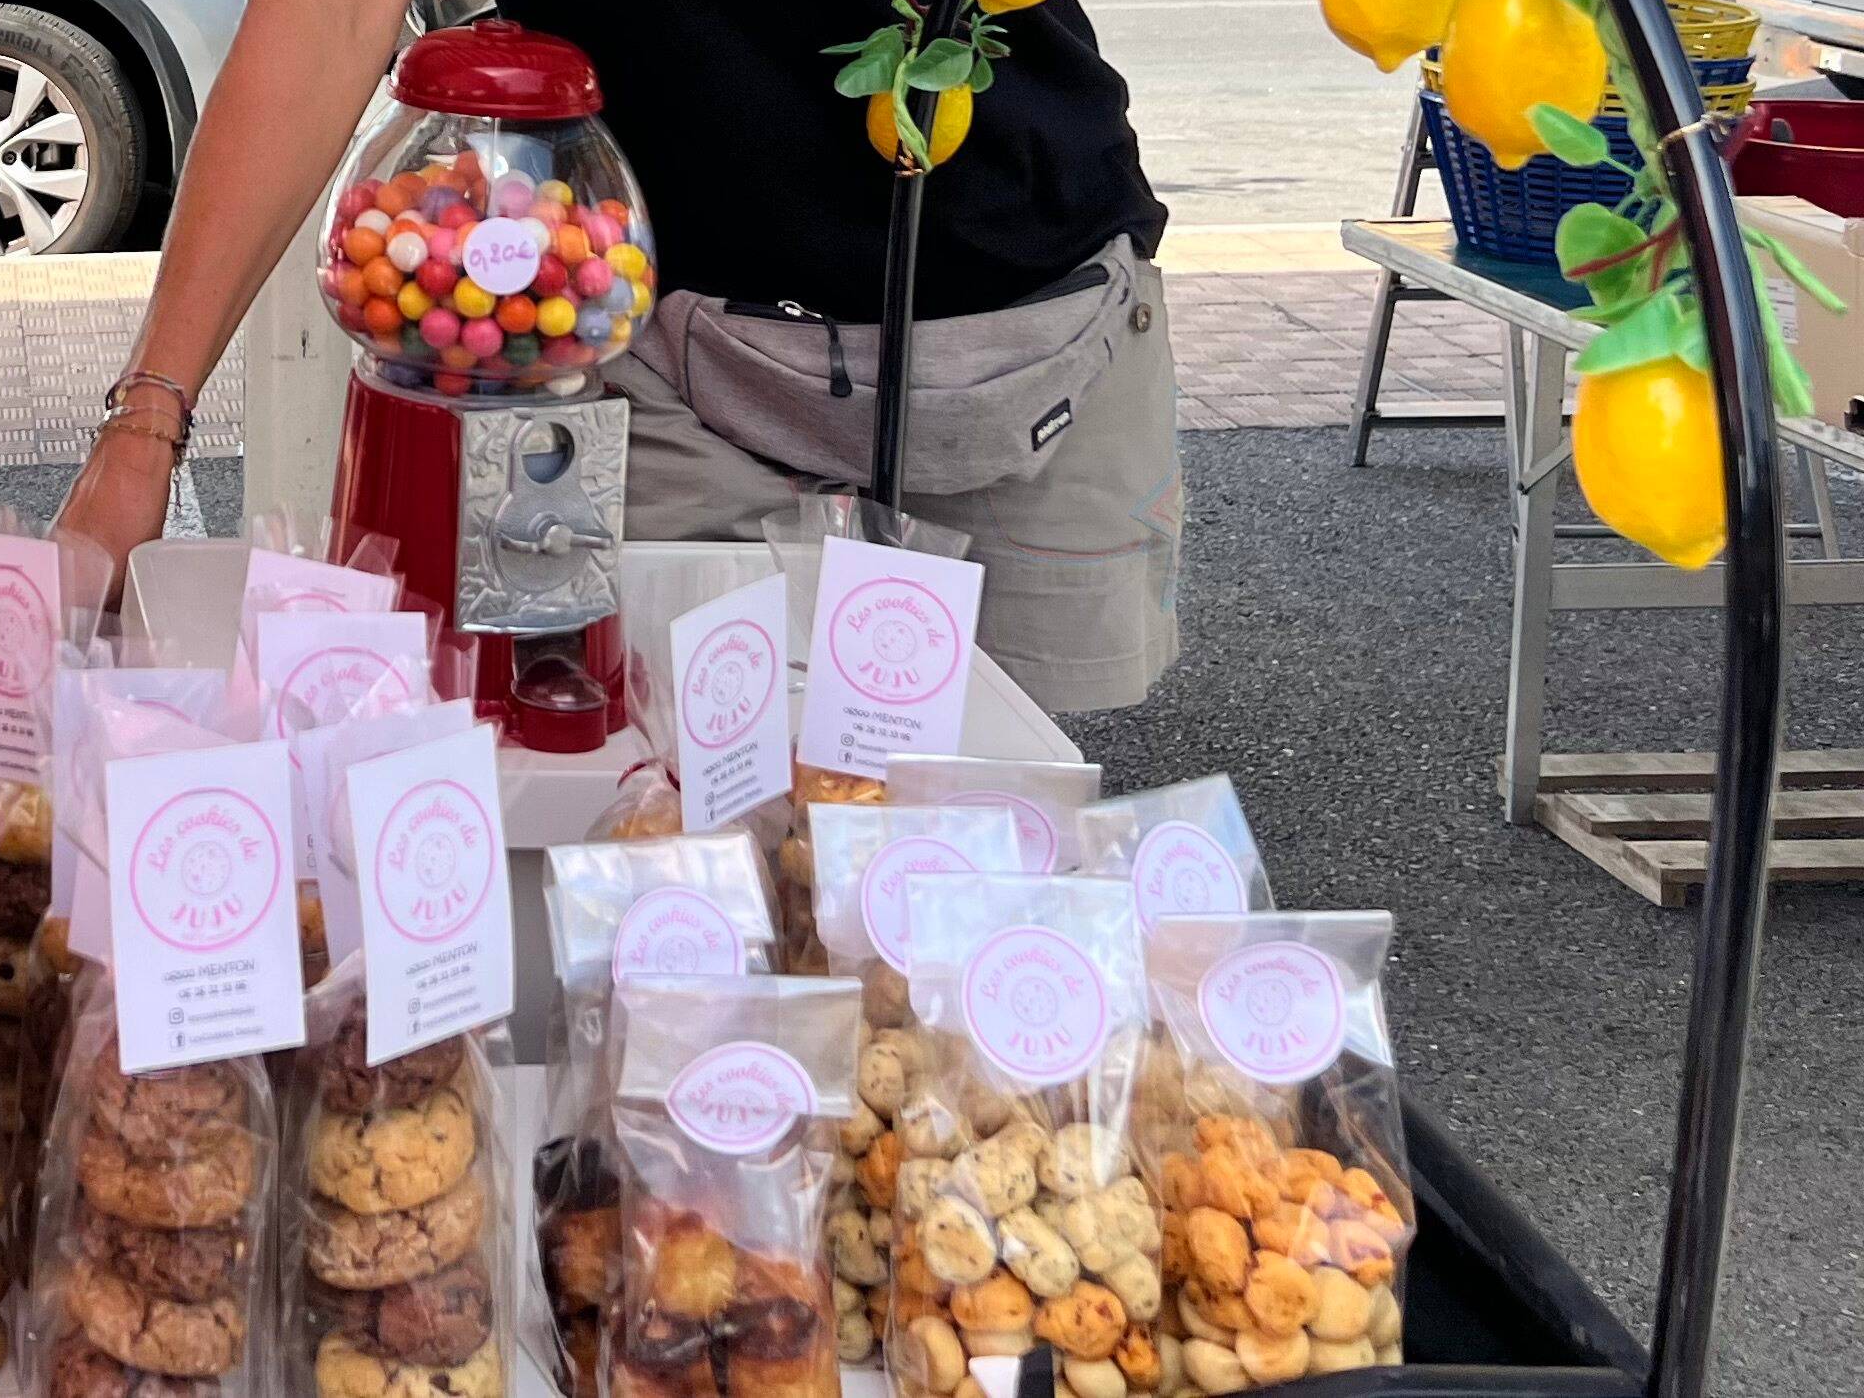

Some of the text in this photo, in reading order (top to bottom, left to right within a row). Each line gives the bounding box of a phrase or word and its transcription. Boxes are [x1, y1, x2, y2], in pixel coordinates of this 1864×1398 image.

[847, 595, 947, 649] Les cookies de
[708, 633, 750, 664] cookies
[857, 660, 920, 688] JUJU
[705, 695, 752, 733] JUJU
[872, 712, 922, 731] MENTON
[176, 804, 243, 836] cookies
[170, 893, 244, 929] JUJU
[409, 881, 469, 922] JUJU
[198, 958, 255, 977] MENTON
[1007, 1024, 1073, 1057] JUJU
[1242, 1027, 1309, 1057] JUJU
